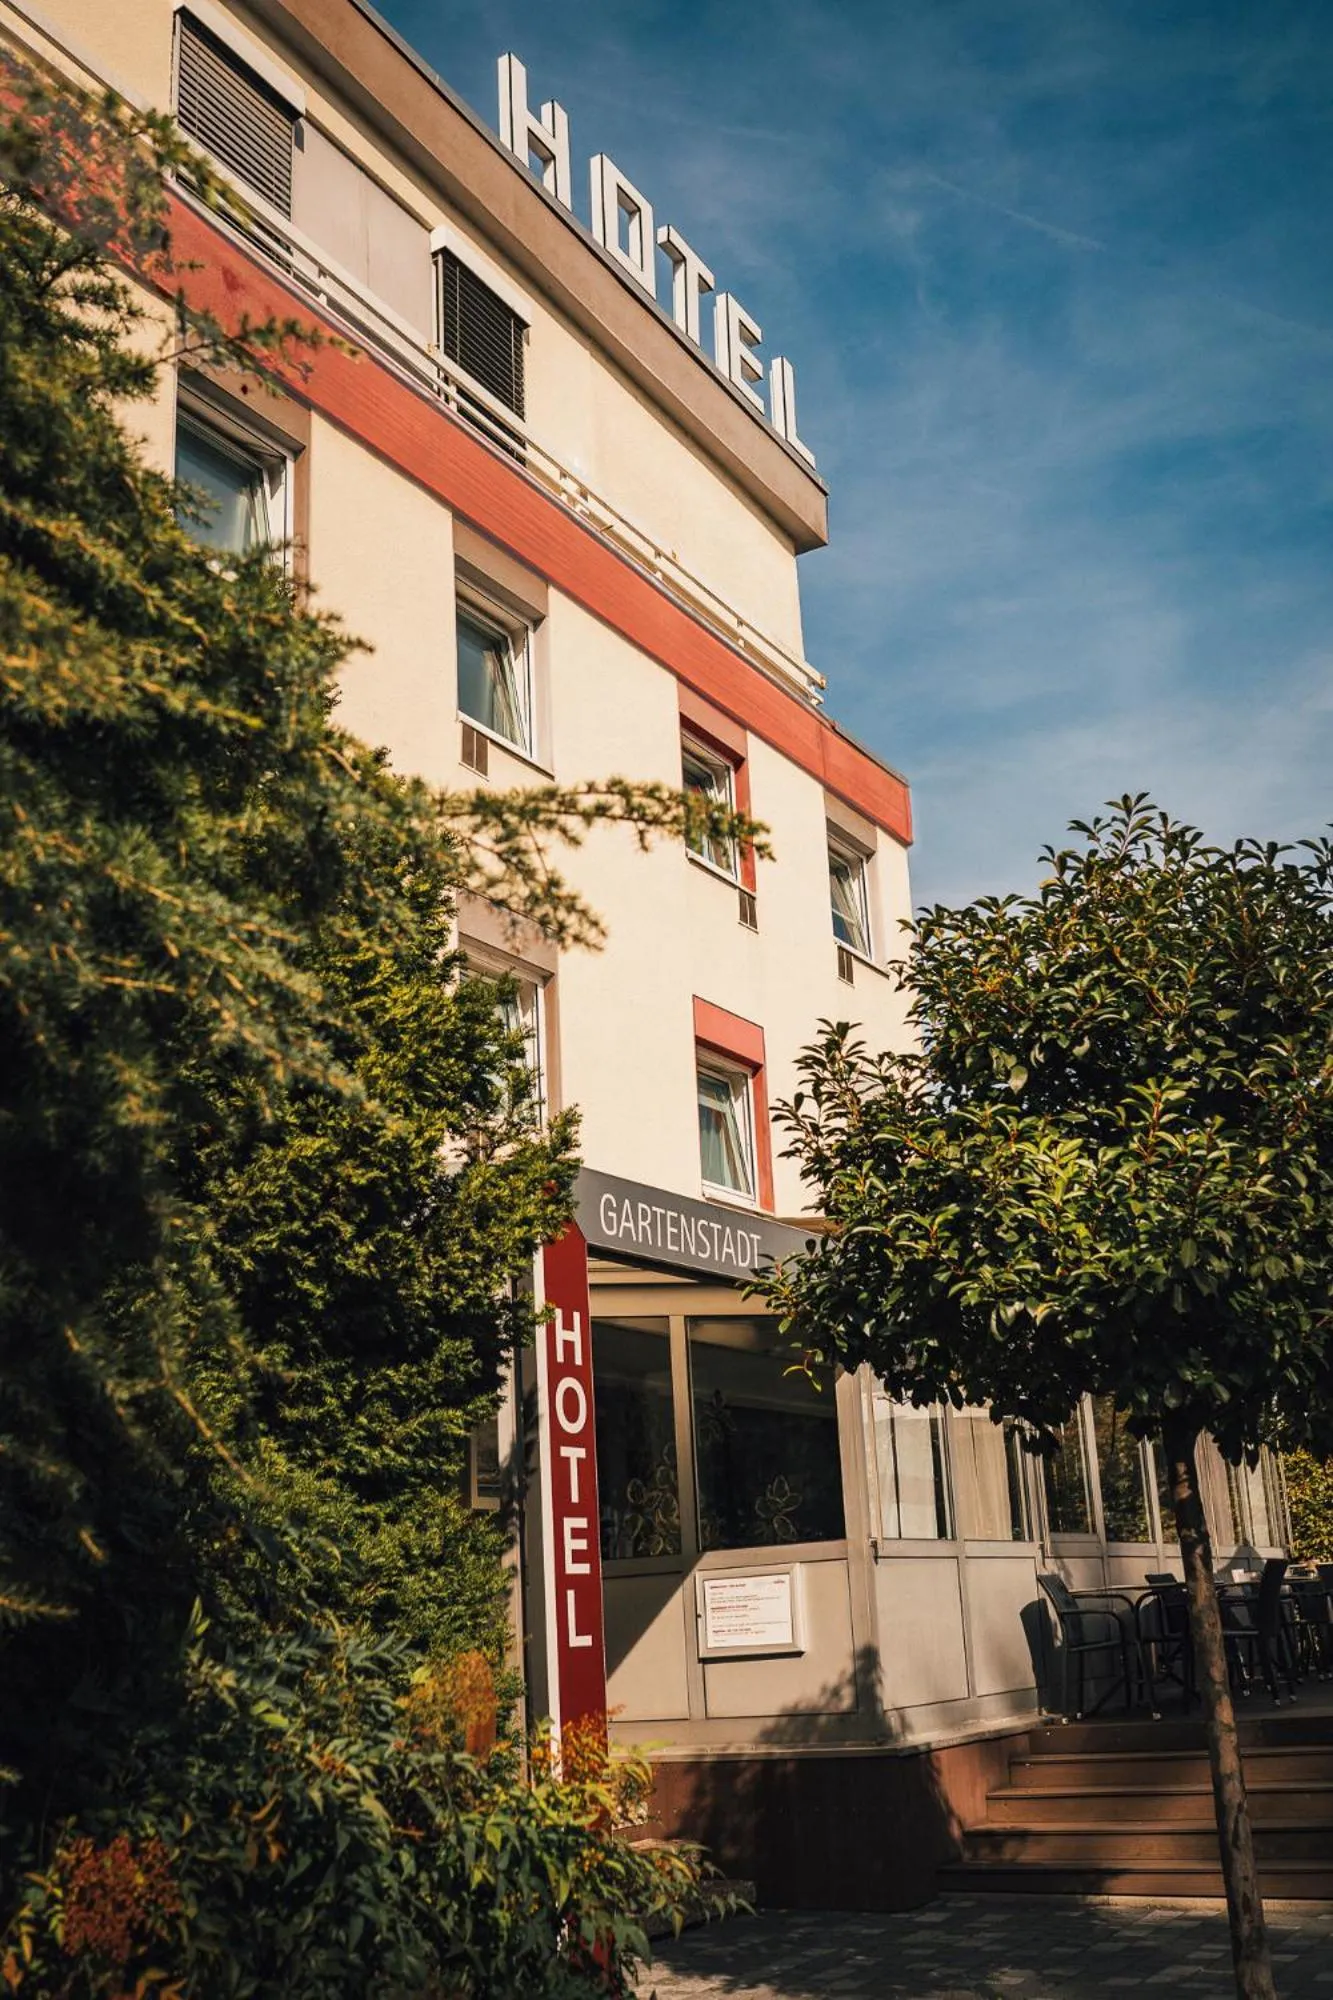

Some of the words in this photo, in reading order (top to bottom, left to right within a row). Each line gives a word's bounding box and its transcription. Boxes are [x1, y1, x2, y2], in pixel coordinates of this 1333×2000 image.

[497, 52, 816, 470] HOTEL
[599, 1193, 762, 1270] GARTENSTADT
[554, 1307, 593, 1648] HOTEL
